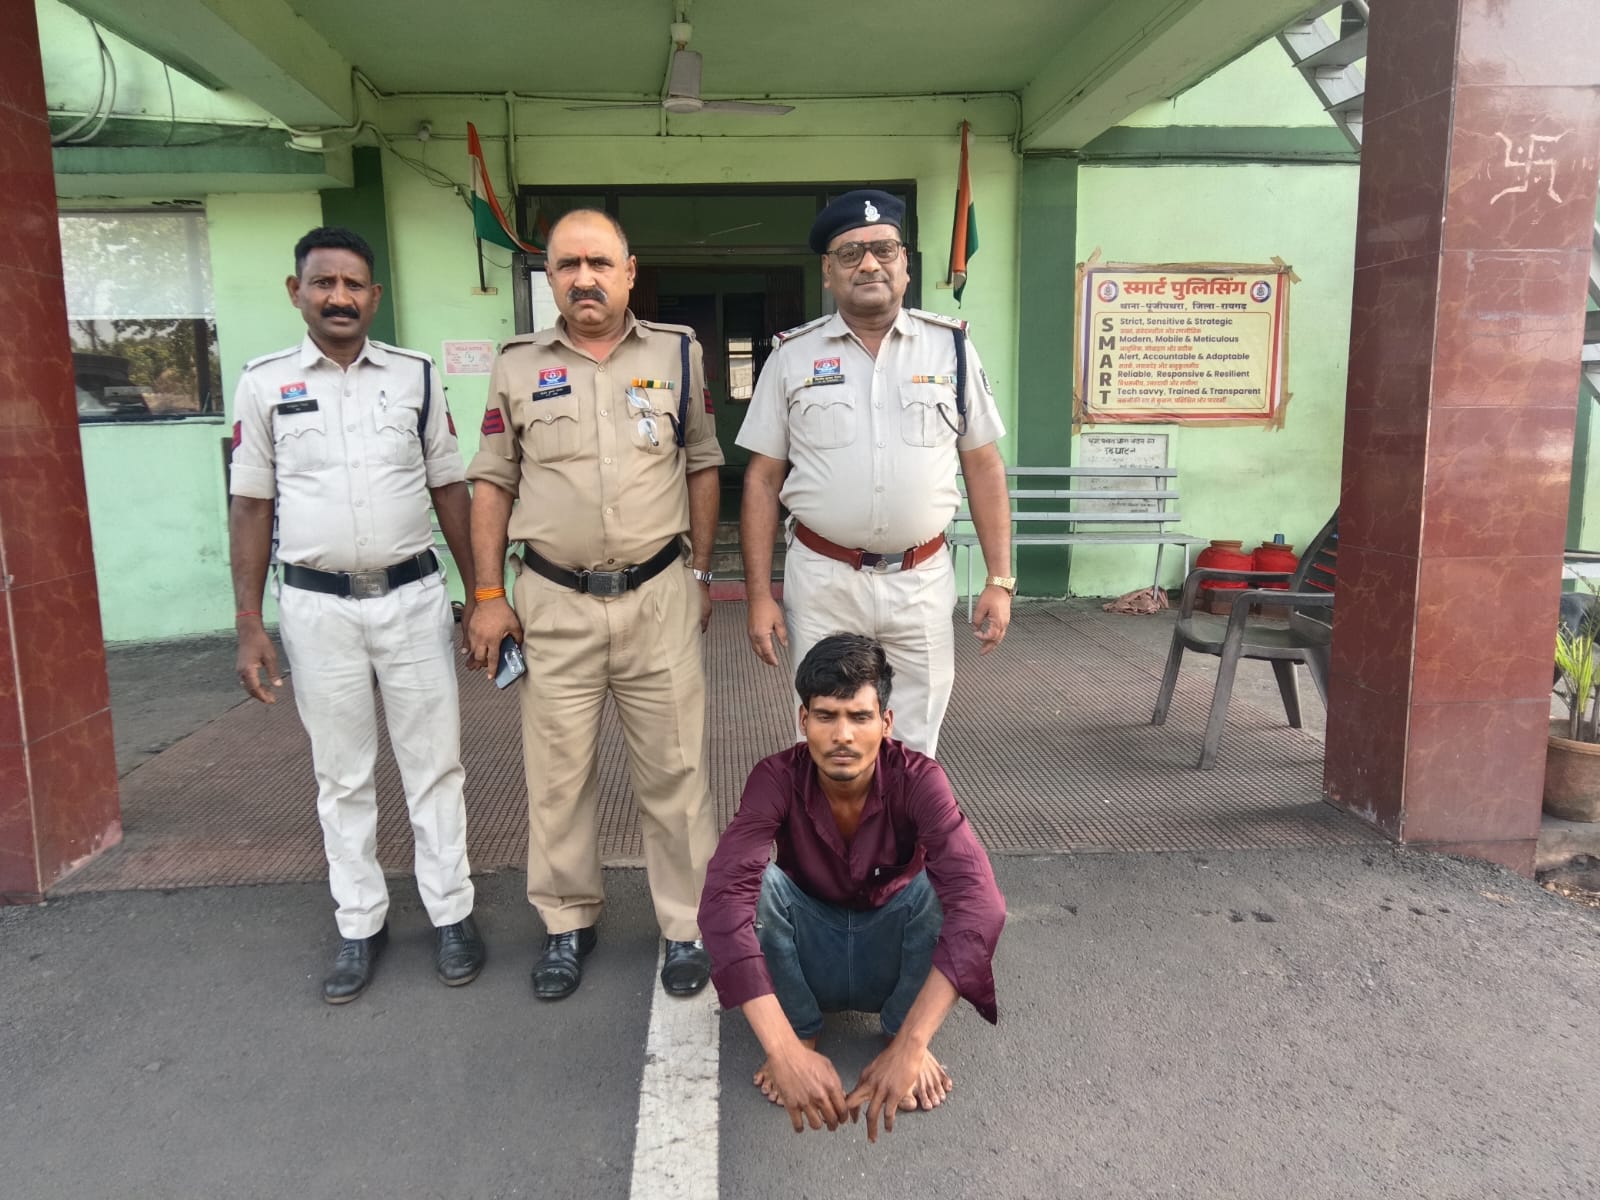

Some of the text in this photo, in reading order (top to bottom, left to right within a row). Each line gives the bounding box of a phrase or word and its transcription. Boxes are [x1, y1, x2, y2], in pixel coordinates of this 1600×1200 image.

[1123, 277, 1247, 300] स्मार्ट पुलिसिंग
[1120, 317, 1145, 326] Strict,
[1146, 317, 1185, 325] Sensitive
[1194, 317, 1233, 327] Strategic
[1119, 335, 1154, 344] Modern,
[1155, 335, 1184, 343] Mobile
[1193, 335, 1239, 343] Meticulous
[1118, 353, 1141, 361] Alert,
[1142, 353, 1196, 361] Accountable
[1205, 353, 1250, 362] Adaptable
[1117, 370, 1153, 379] Reliable,
[1156, 370, 1205, 380] Responsive
[1214, 370, 1250, 378] Resilient
[1117, 388, 1262, 397] Tech savvy, Trained & Transparent
